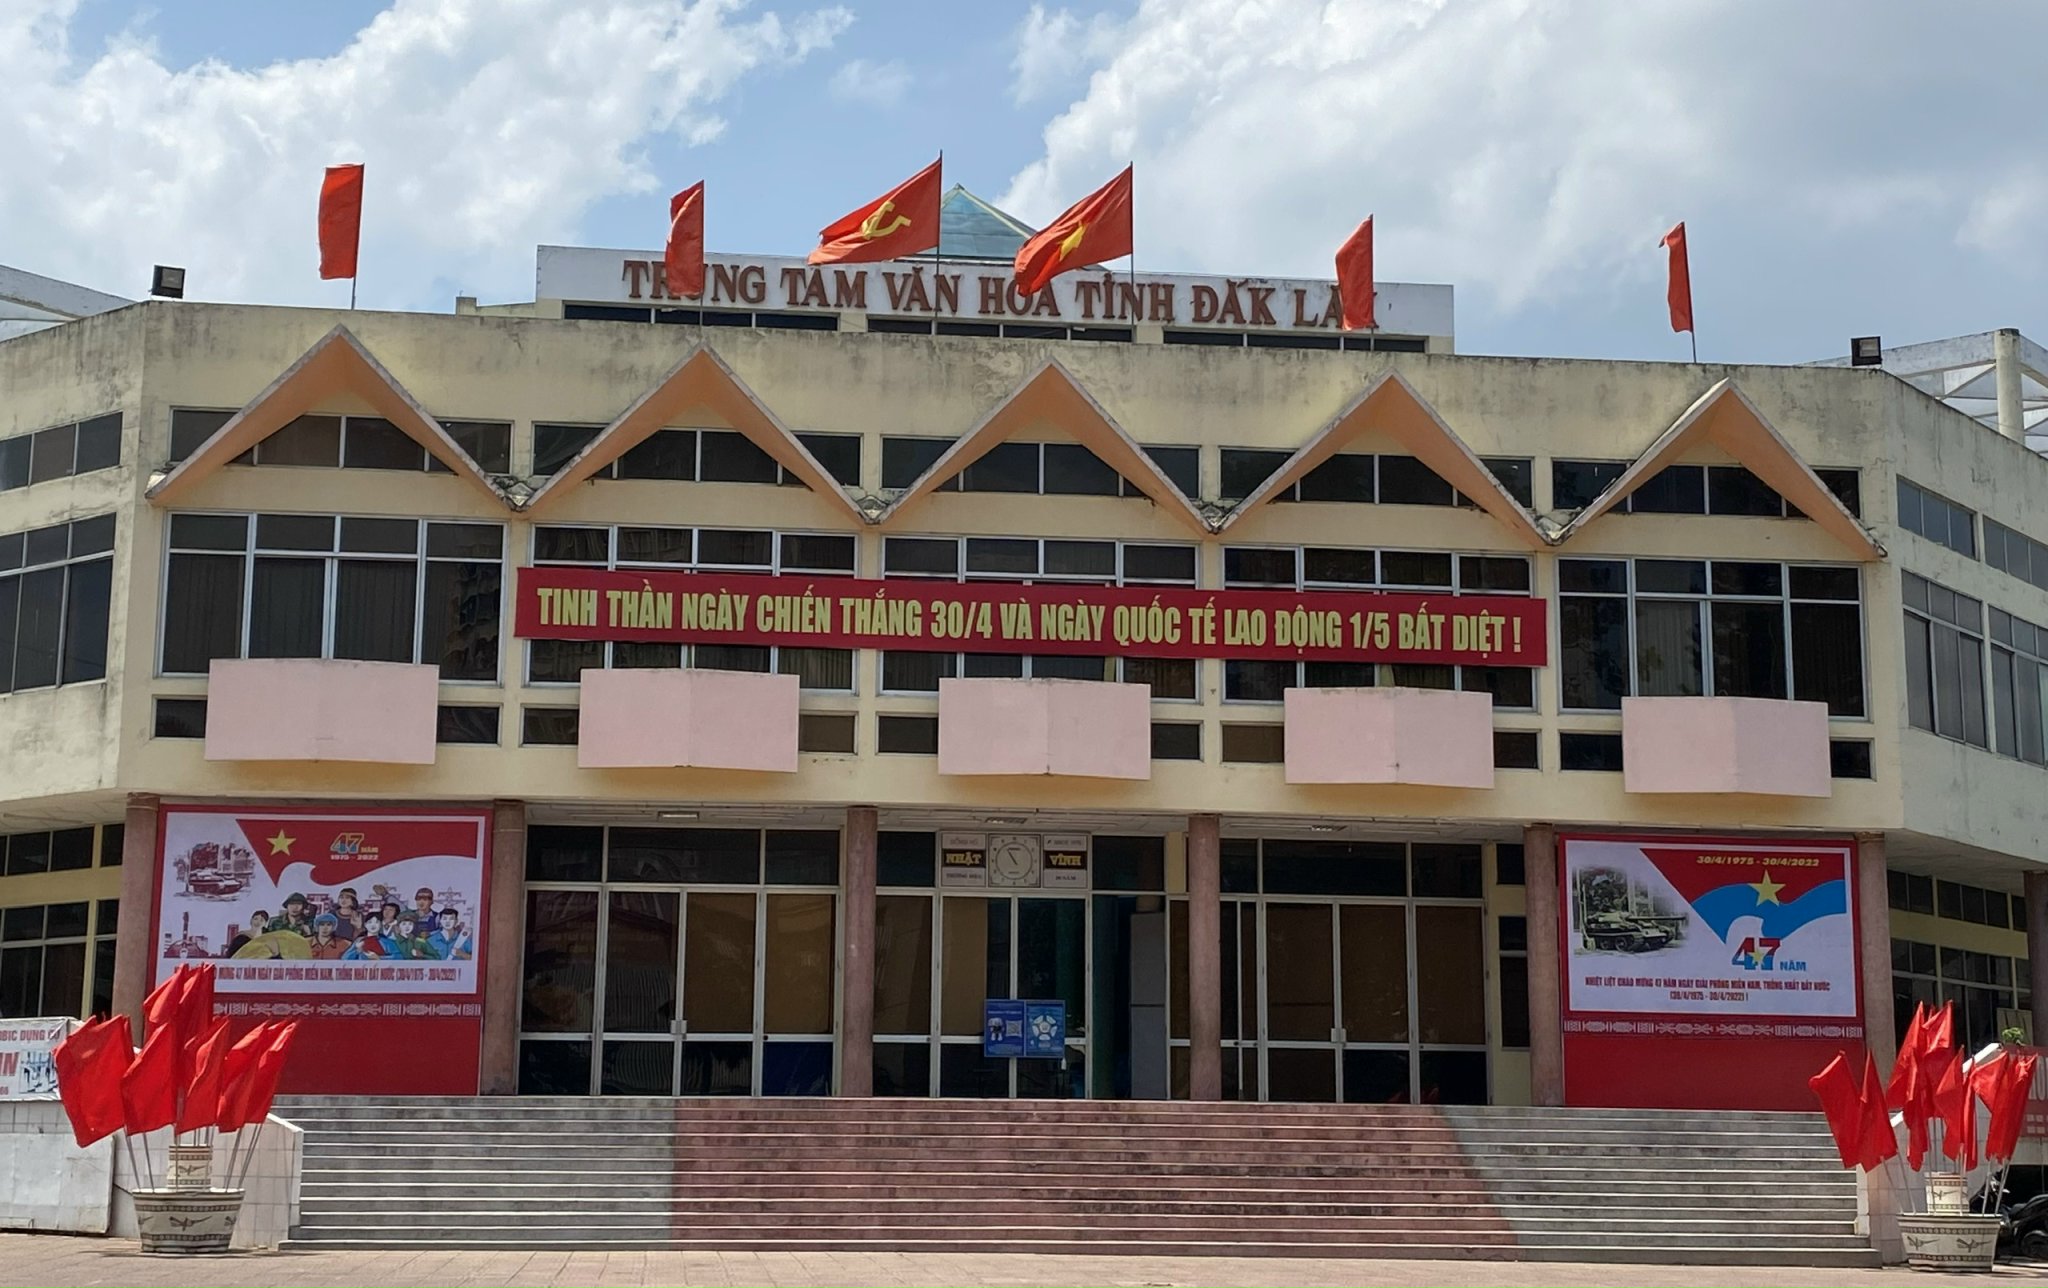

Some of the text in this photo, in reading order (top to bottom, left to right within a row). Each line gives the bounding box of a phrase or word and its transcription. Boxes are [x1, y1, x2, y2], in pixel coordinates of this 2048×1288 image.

[622, 260, 766, 304] TRNG
[882, 266, 961, 313] VĂN
[1190, 278, 1277, 325] ĐẮK
[537, 579, 1522, 659] TINH THẦN NGÀY CHIẾN THẮNG 30/4 VÀ NGÀY QUỐC TẾ LAO ĐỘNG 1/5 BẤT DIỆT !
[330, 832, 364, 854] 47
[946, 851, 982, 866] NHẬT
[1696, 856, 1755, 865] 30/4/1975
[1762, 858, 1820, 867] 30/4/2022
[1731, 937, 1806, 971] 47 NĂM
